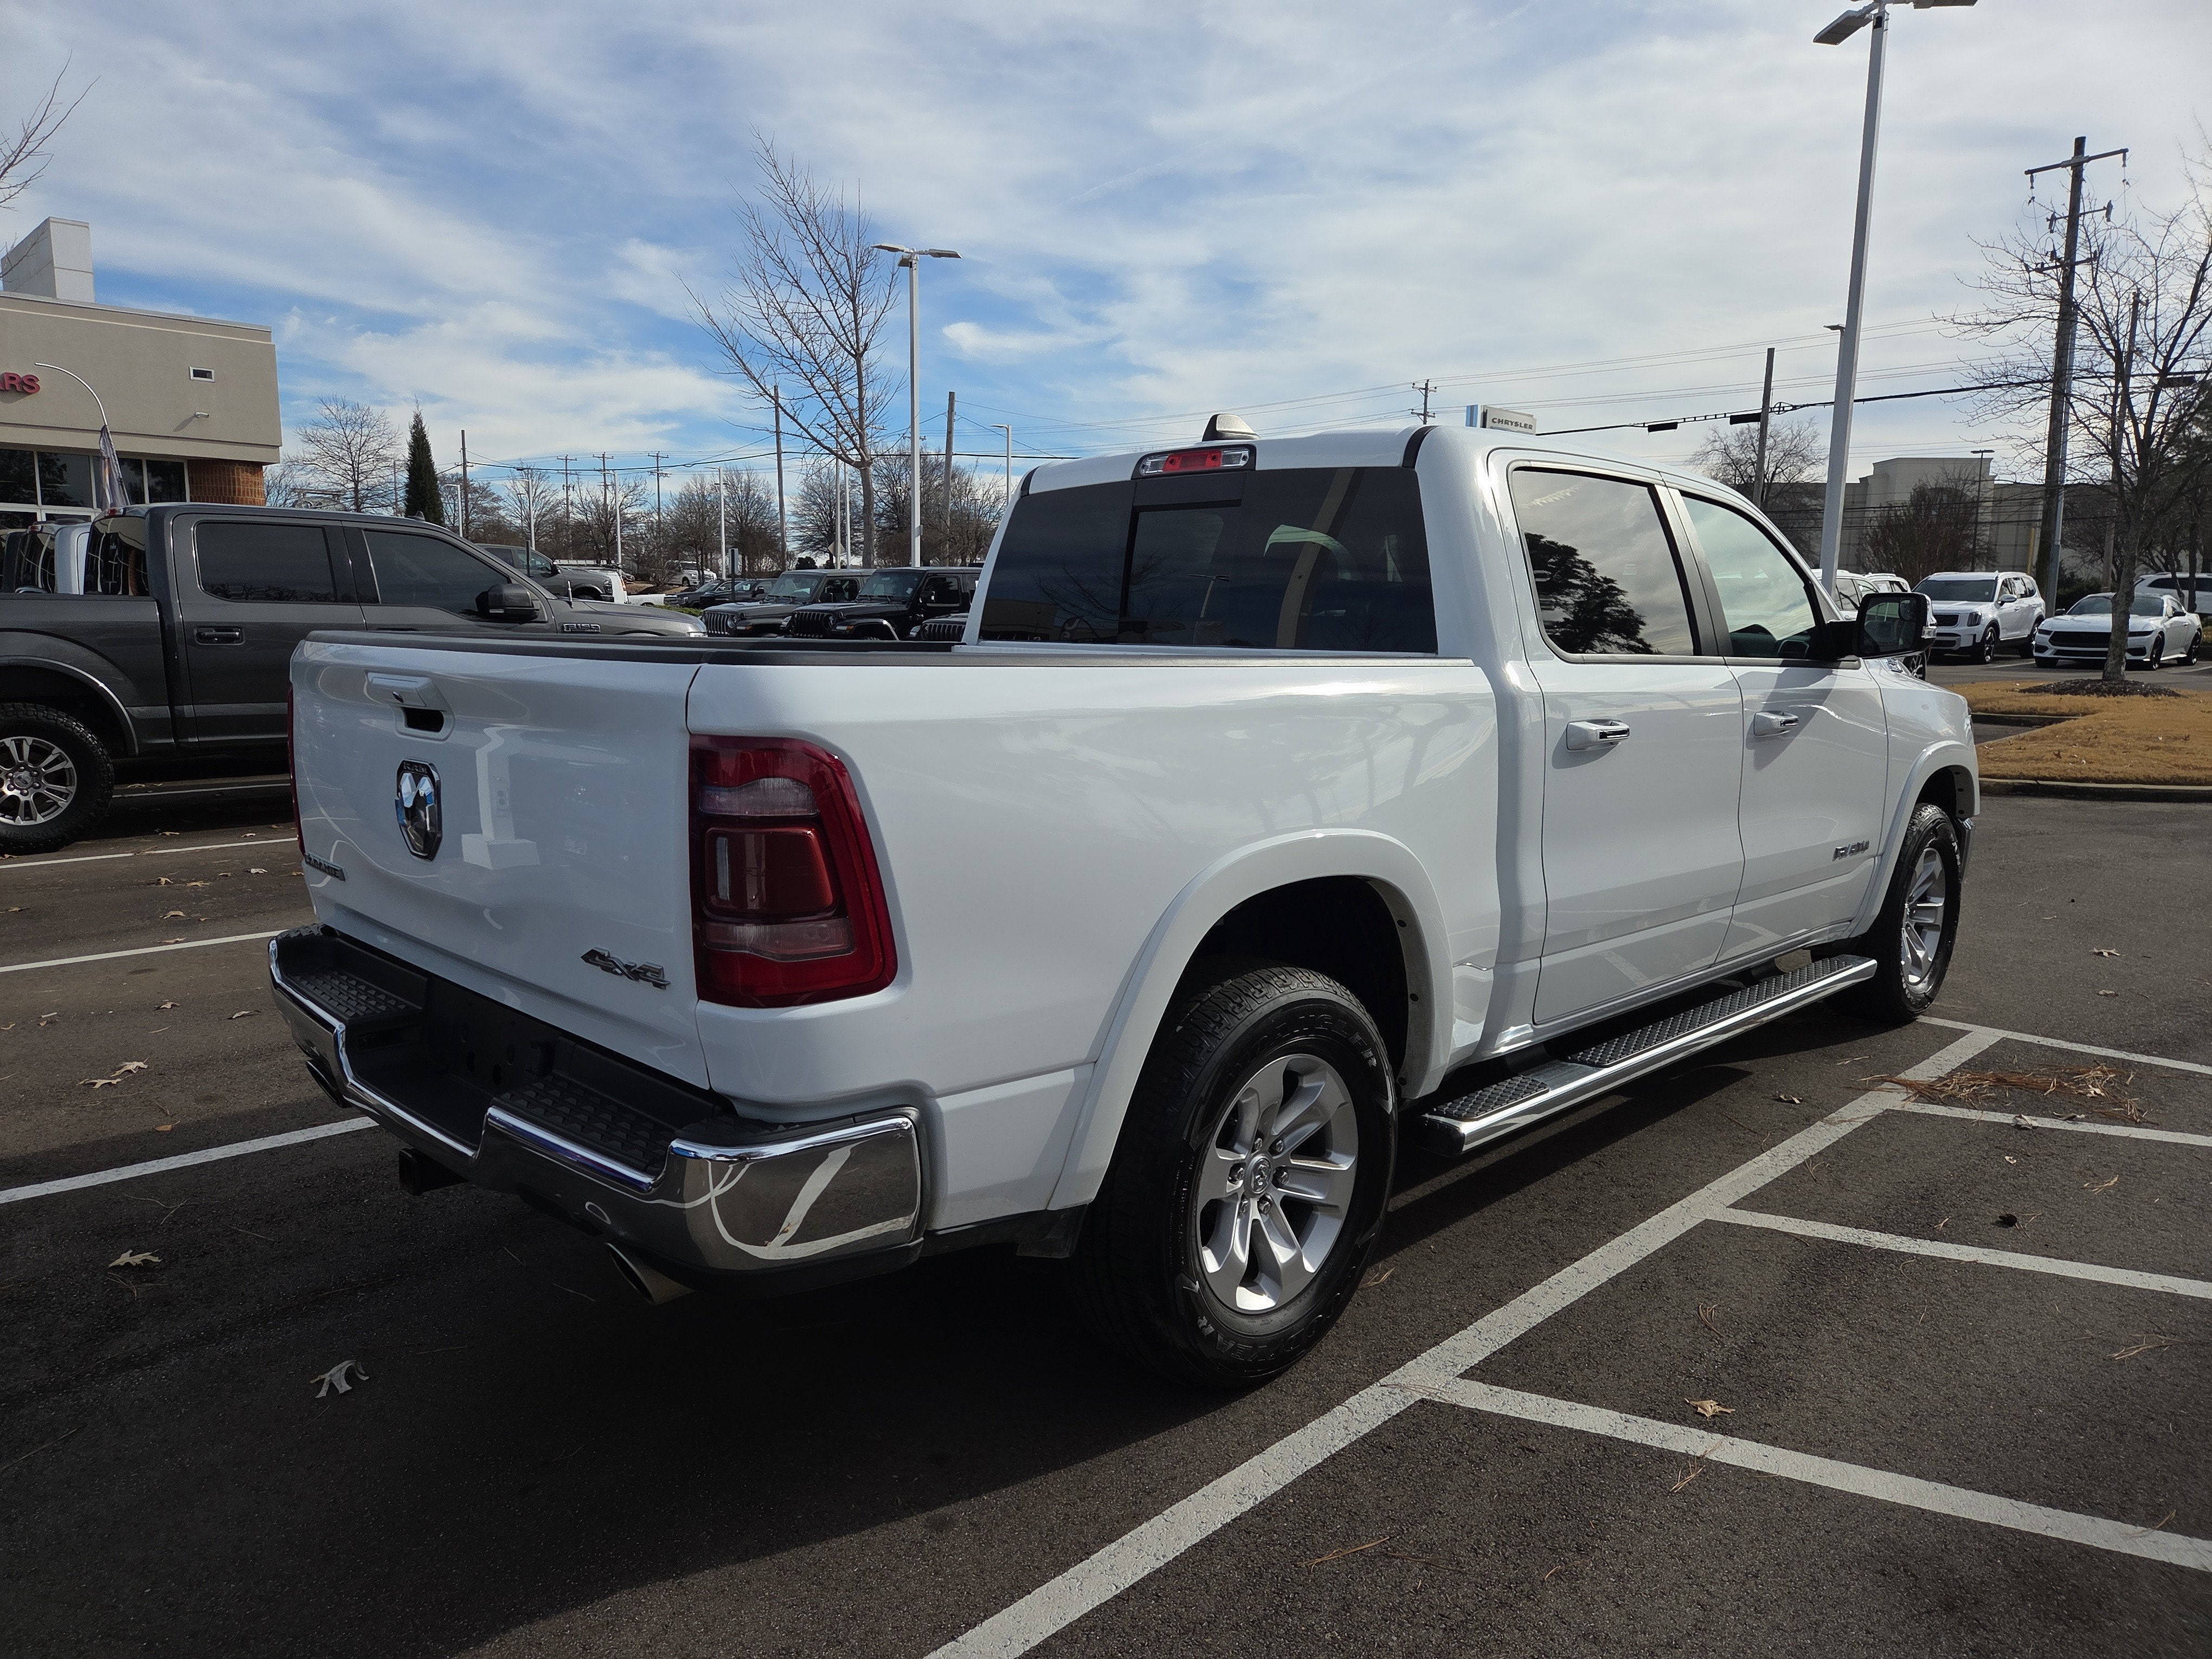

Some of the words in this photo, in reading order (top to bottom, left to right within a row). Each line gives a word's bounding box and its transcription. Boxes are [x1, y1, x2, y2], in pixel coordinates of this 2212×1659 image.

[0, 372, 41, 394] RS
[1491, 417, 1533, 430] CHRYSLER
[1832, 840, 1869, 861] RAM
